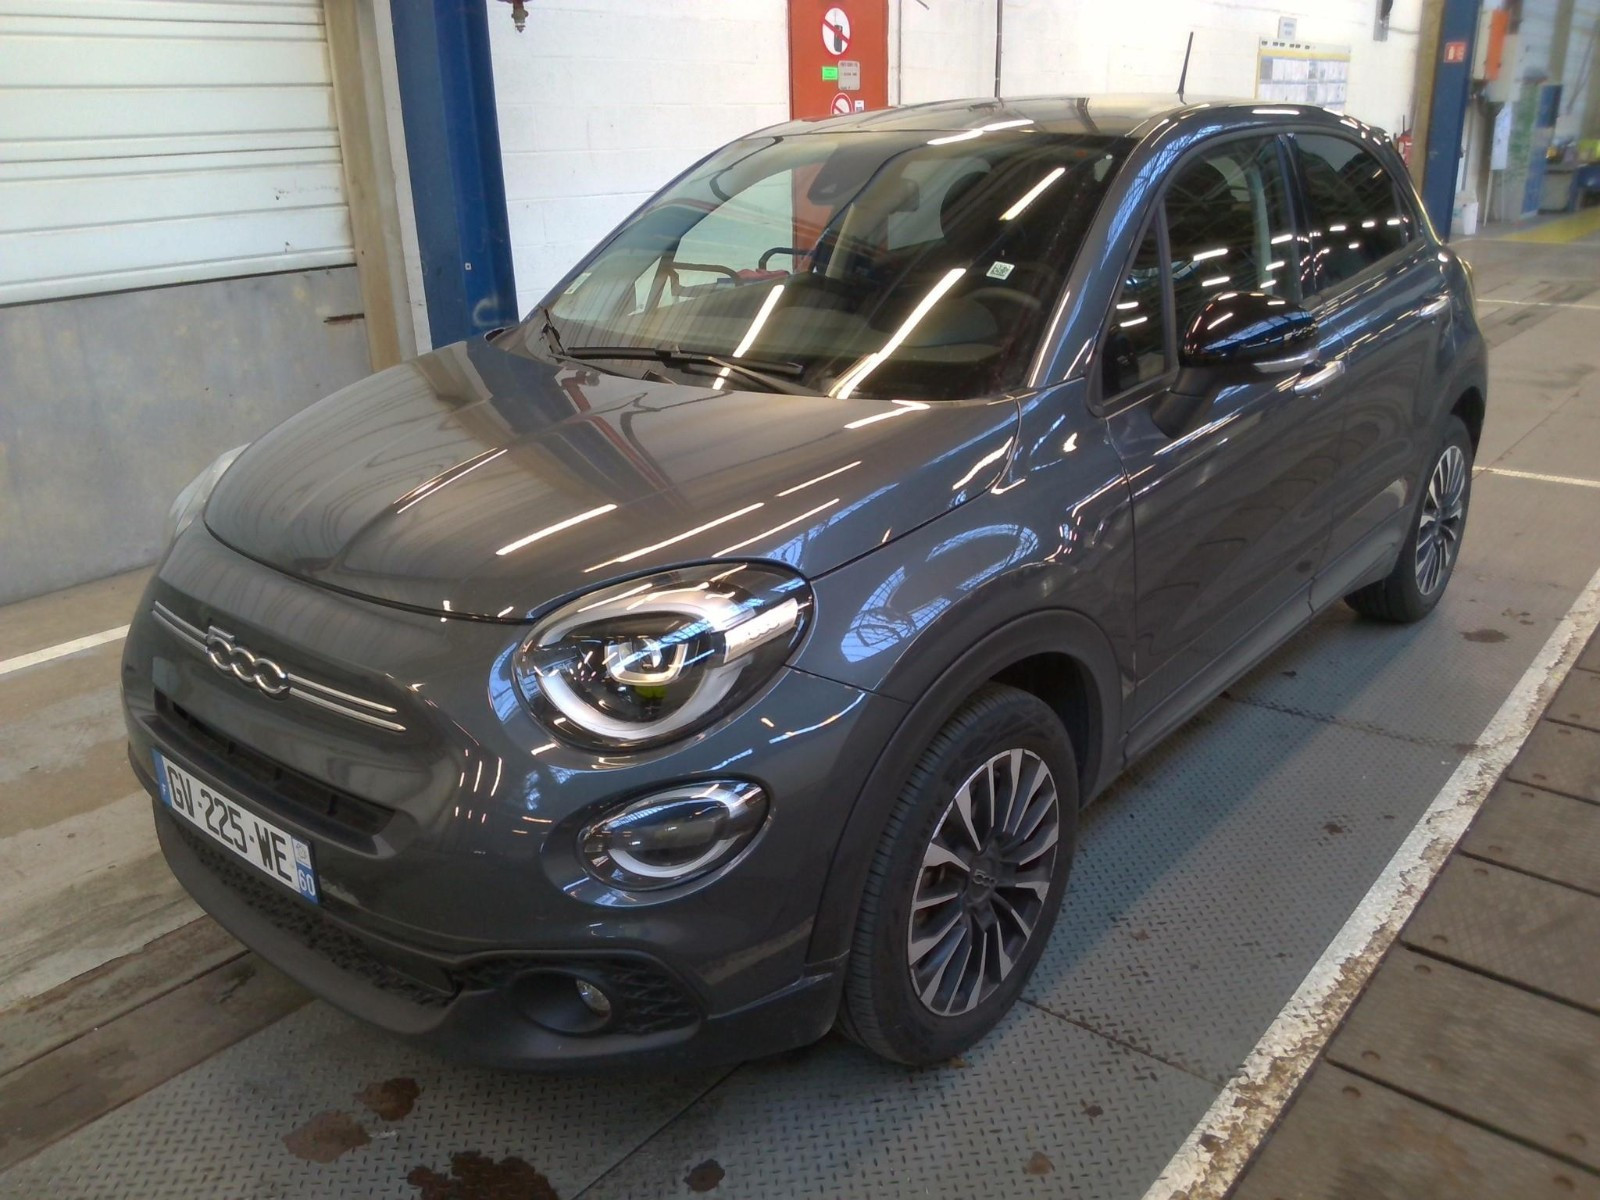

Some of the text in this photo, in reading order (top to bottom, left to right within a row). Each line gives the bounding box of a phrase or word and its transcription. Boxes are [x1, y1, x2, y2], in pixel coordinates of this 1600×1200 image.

[207, 625, 288, 693] 500
[167, 765, 293, 883] GV-225-WE
[298, 869, 316, 897] 60
